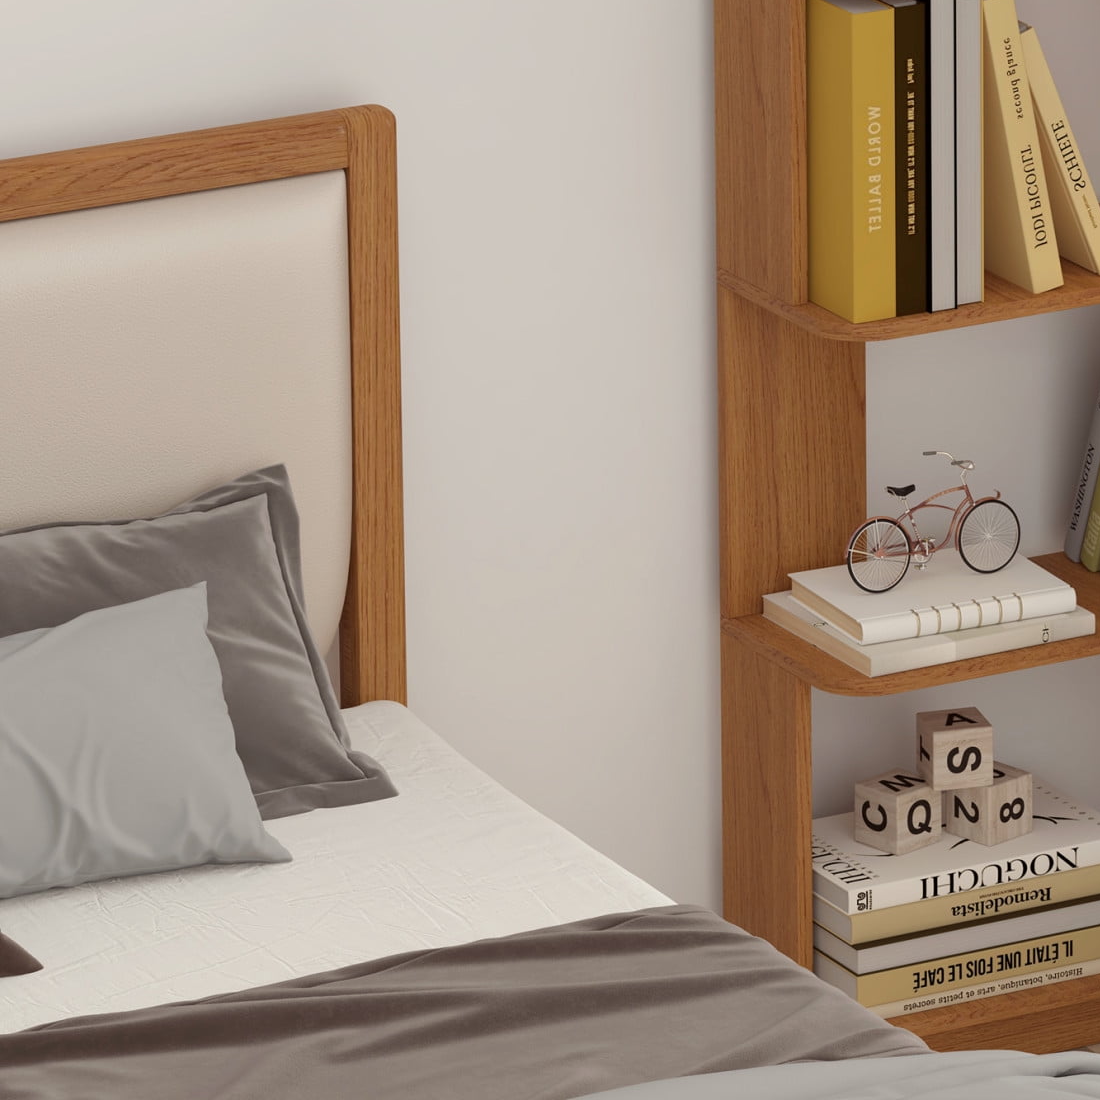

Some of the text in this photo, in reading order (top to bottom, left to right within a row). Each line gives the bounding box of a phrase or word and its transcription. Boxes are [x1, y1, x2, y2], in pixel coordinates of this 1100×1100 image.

[1070, 444, 1095, 531] WASHINGTON
[945, 712, 978, 726] A
[920, 735, 930, 762] T
[947, 746, 982, 774] S
[862, 800, 887, 832] C
[907, 800, 932, 835] Q
[954, 795, 979, 823] 2
[1000, 798, 1025, 823] 8
[920, 847, 1079, 899] NOGUCHI
[951, 887, 1052, 917] Remodelista
[913, 940, 1073, 992] IL ÉTAIT UNE FOIS LE CAFÉ
[1046, 967, 1083, 980] Histoire,
[977, 986, 995, 995] arts
[998, 975, 1043, 990] botanique,
[904, 1000, 936, 1011] secrets
[938, 993, 962, 1005] petits
